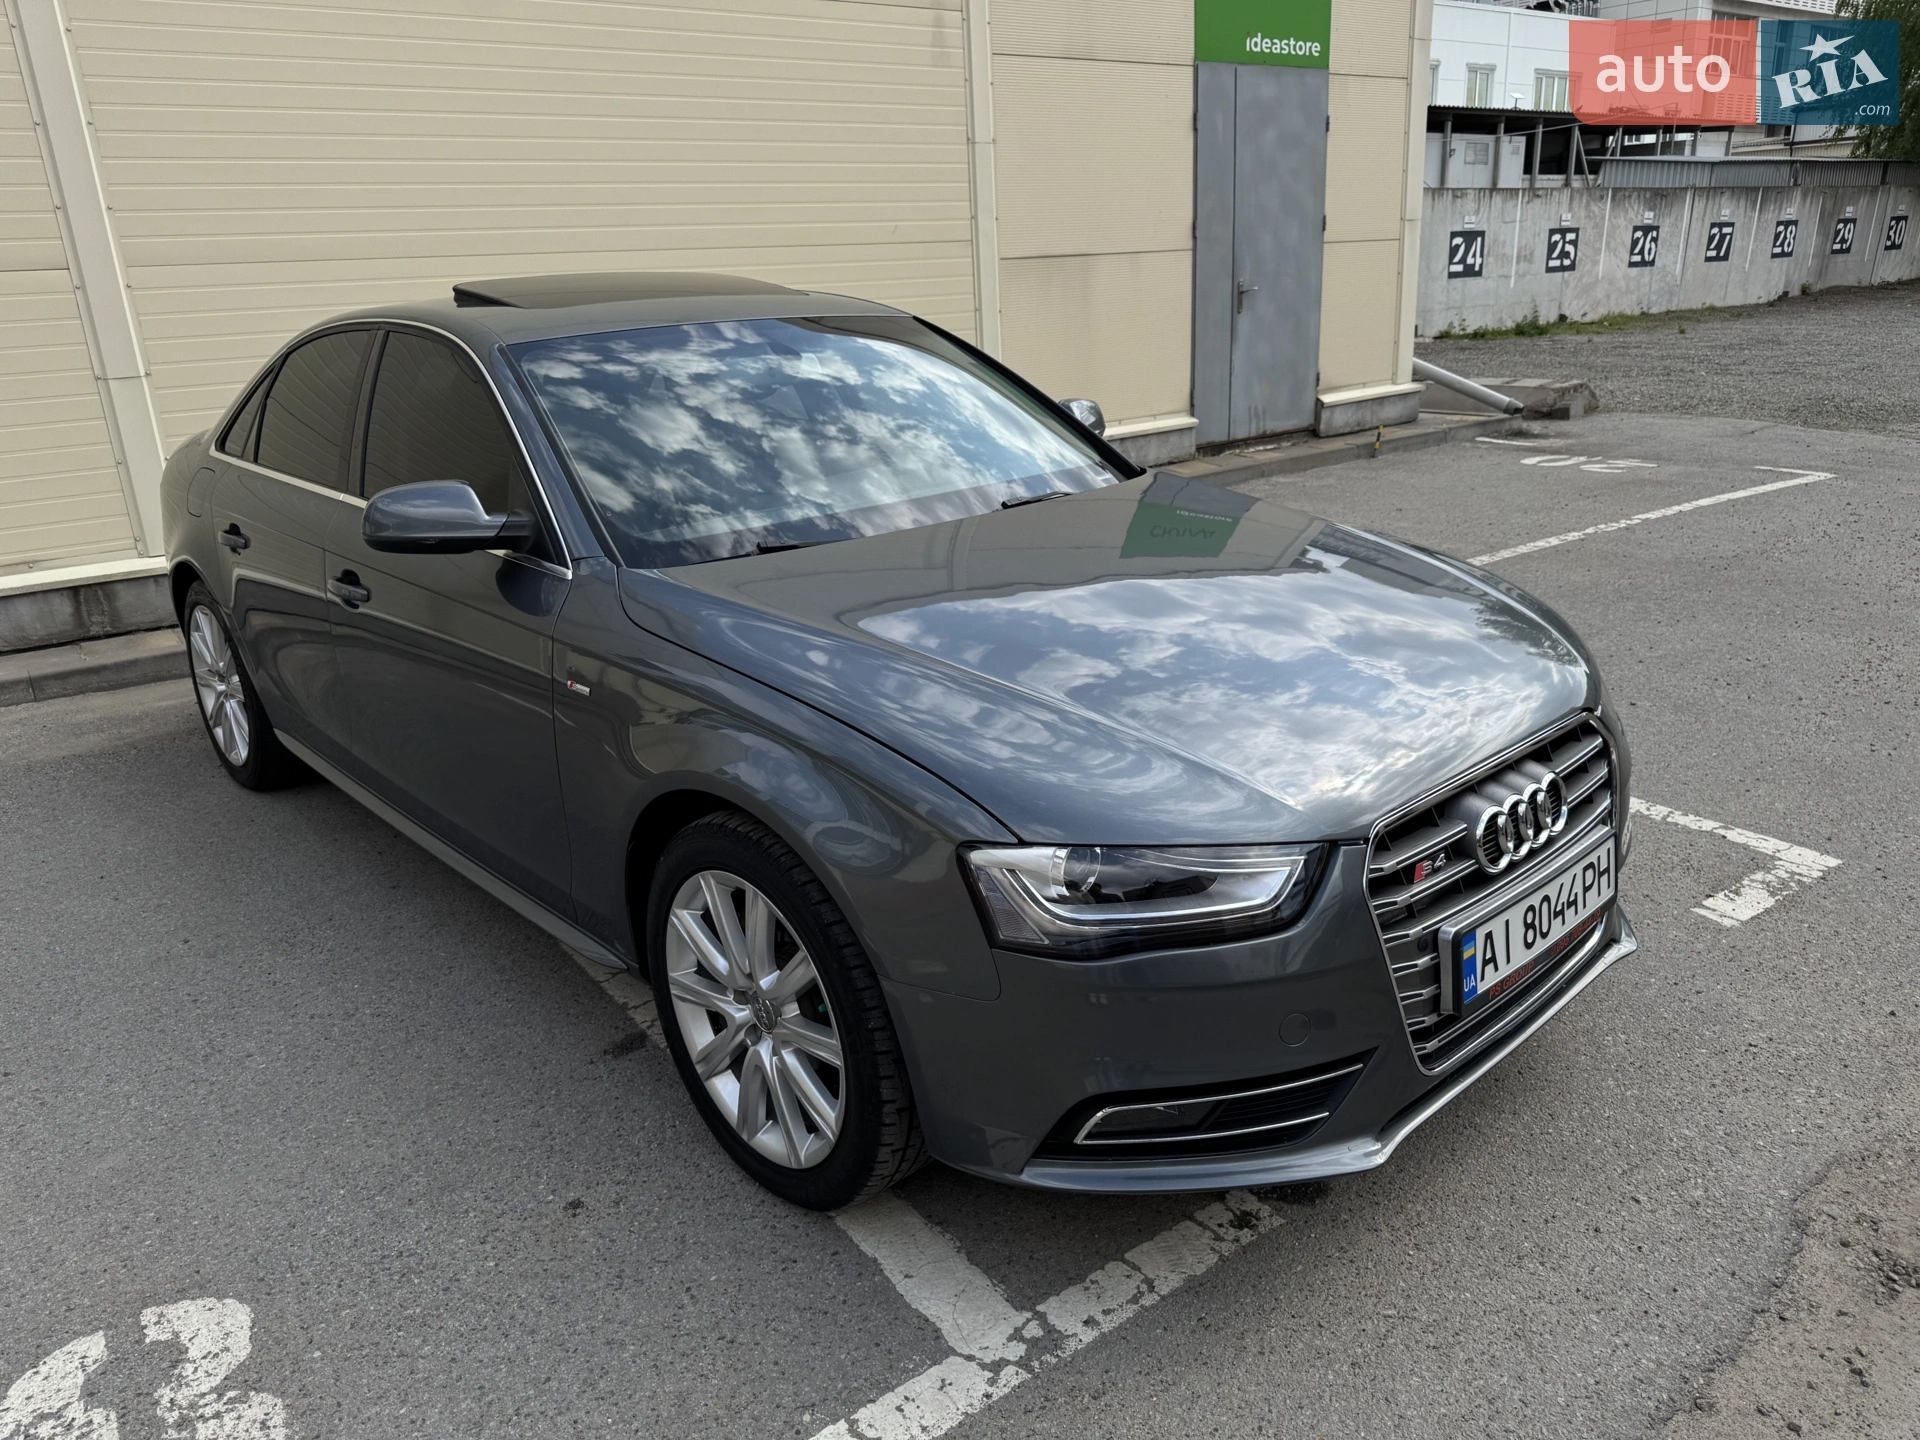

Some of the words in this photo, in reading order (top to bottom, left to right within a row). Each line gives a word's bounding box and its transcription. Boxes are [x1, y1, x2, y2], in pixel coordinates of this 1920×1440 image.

[1246, 31, 1321, 56] ideastore
[1629, 230, 1658, 263] 26
[1705, 226, 1734, 257] 27
[1772, 223, 1797, 254] 28
[1831, 221, 1855, 250] 29
[1885, 219, 1906, 247] 30
[1449, 236, 1483, 273] 24
[1547, 232, 1577, 267] 25
[1420, 853, 1447, 876] S4
[1480, 918, 1511, 983] AI
[1463, 973, 1476, 992] UA
[1488, 985, 1501, 1000] PS
[1503, 961, 1536, 991] GROUP
